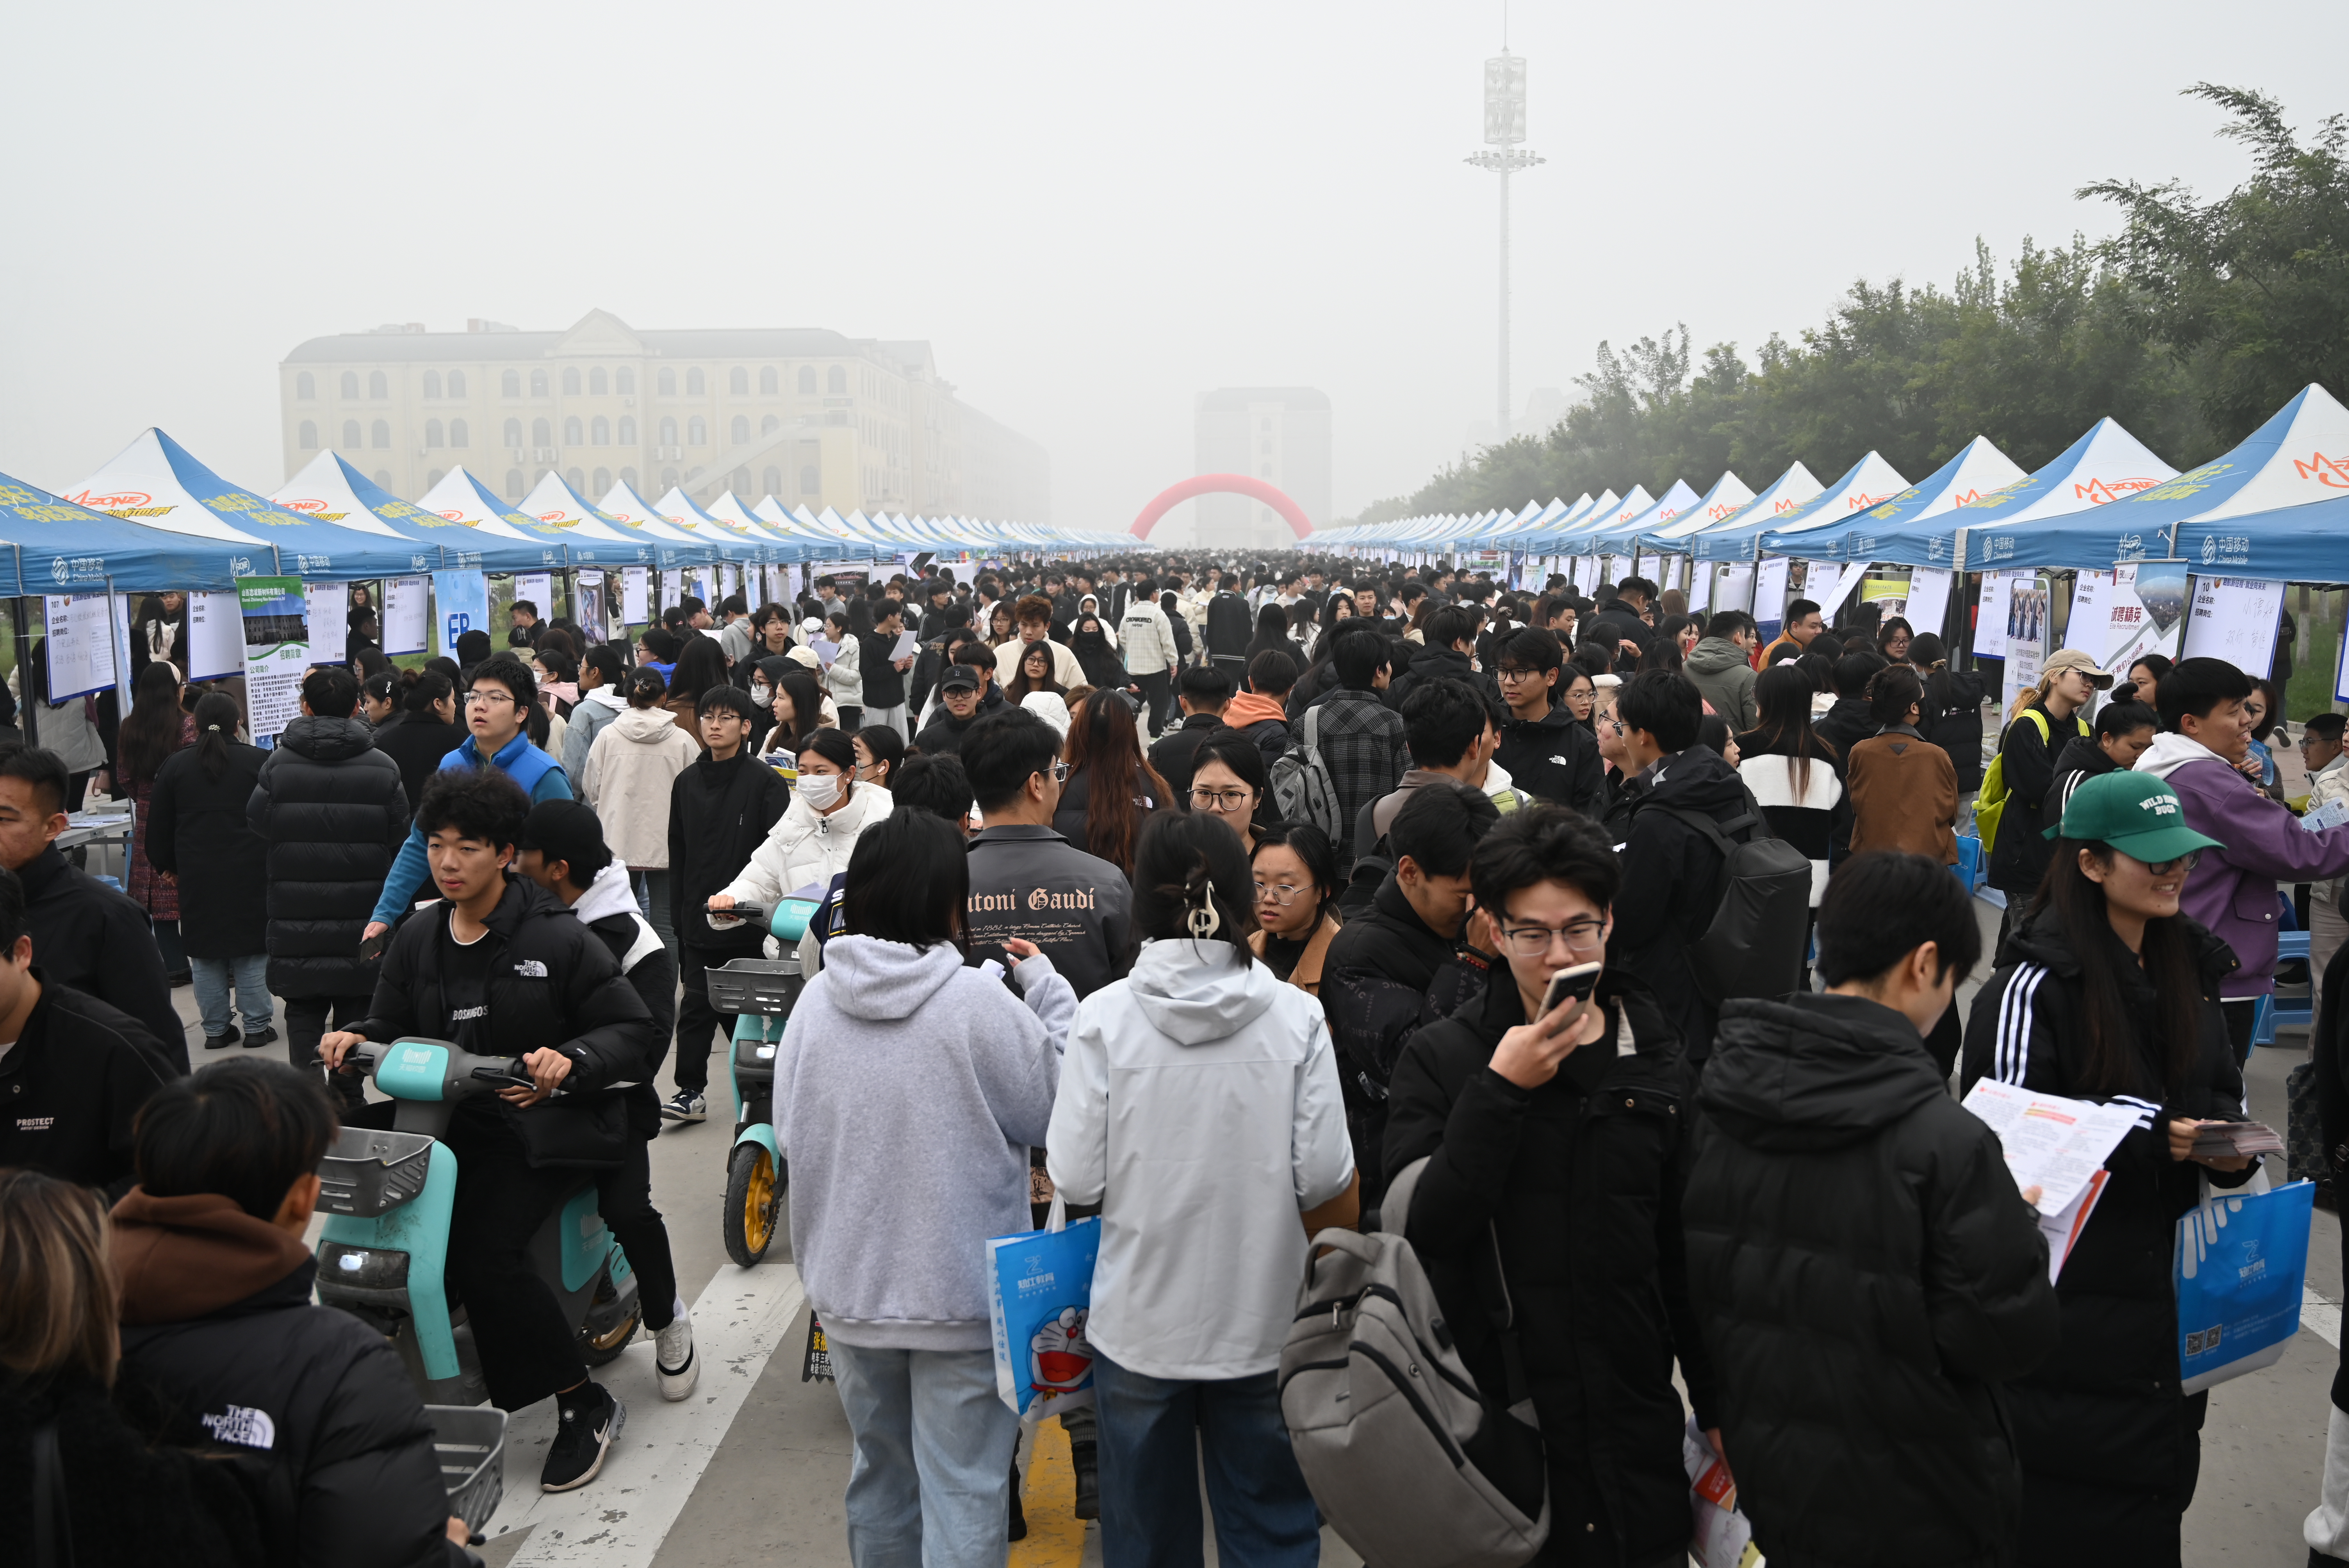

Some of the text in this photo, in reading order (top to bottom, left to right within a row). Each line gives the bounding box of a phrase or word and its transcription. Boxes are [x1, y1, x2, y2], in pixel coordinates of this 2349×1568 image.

[1994, 536, 2014, 550] 中国移动
[2219, 536, 2249, 552] 中国移动
[71, 558, 104, 572] 中国移动
[309, 556, 330, 567] 中国移动
[73, 572, 105, 582] China Mobile
[2079, 583, 2095, 593] 企业名称:
[2203, 582, 2210, 592] 10
[2222, 577, 2267, 591] 启航新征程·就业向未来
[242, 588, 285, 597] 山西志诚新材料有限公司
[2077, 595, 2092, 604] 招聘岗位:
[2197, 595, 2215, 605] 企业名称:
[2111, 606, 2142, 623] 诚聘精英
[2194, 608, 2213, 618] 招聘岗位:
[280, 648, 302, 660] 招聘简章
[2110, 642, 2144, 677] 于我们公司品牌
[250, 665, 269, 674] 公司简介
[2139, 796, 2164, 810] WILD
[2154, 804, 2176, 815] BUGS
[17, 1117, 54, 1126] PROSTECT
[1018, 1272, 1055, 1289] 知仕教育
[226, 1404, 254, 1417] THE
[201, 1412, 253, 1431] NORTH
[214, 1428, 249, 1444] FACE
